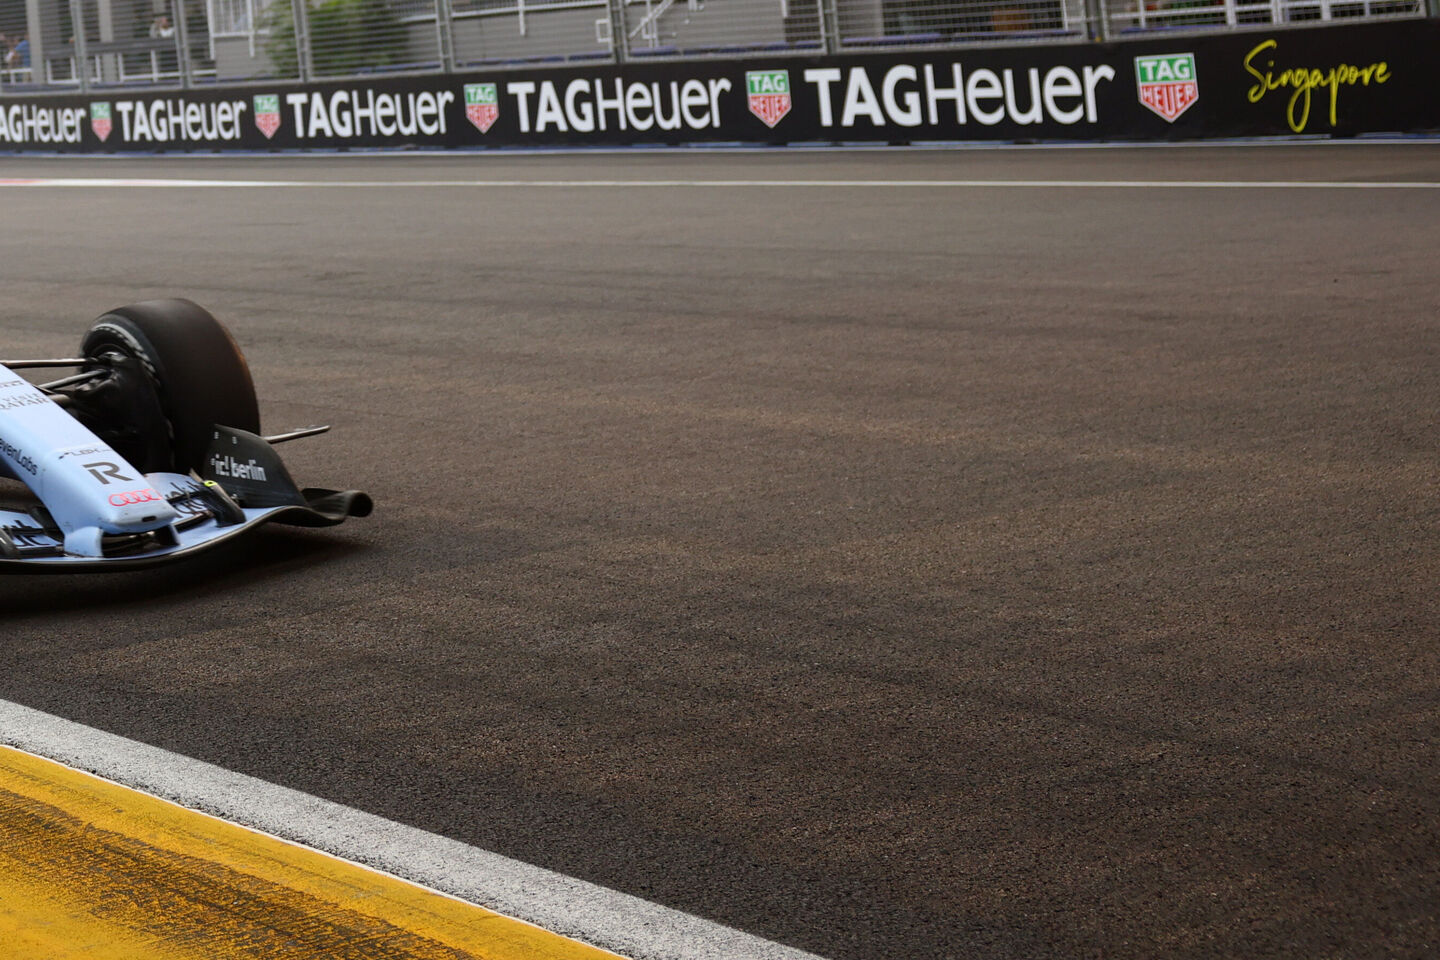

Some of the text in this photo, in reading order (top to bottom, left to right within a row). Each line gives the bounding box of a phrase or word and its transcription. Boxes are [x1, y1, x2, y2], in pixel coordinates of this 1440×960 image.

[750, 74, 787, 92] TAG
[1141, 57, 1190, 81] TAG
[467, 87, 496, 103] TAG
[804, 63, 1115, 127] TAGHeuer
[1142, 83, 1195, 116] HEUER
[1244, 39, 1392, 133] Singapore
[115, 99, 247, 142] TAGHeuer
[286, 89, 454, 139] TAGHeuer
[507, 77, 732, 133] TAGHeuer
[750, 94, 792, 124] HEUER
[230, 456, 267, 481] berlin
